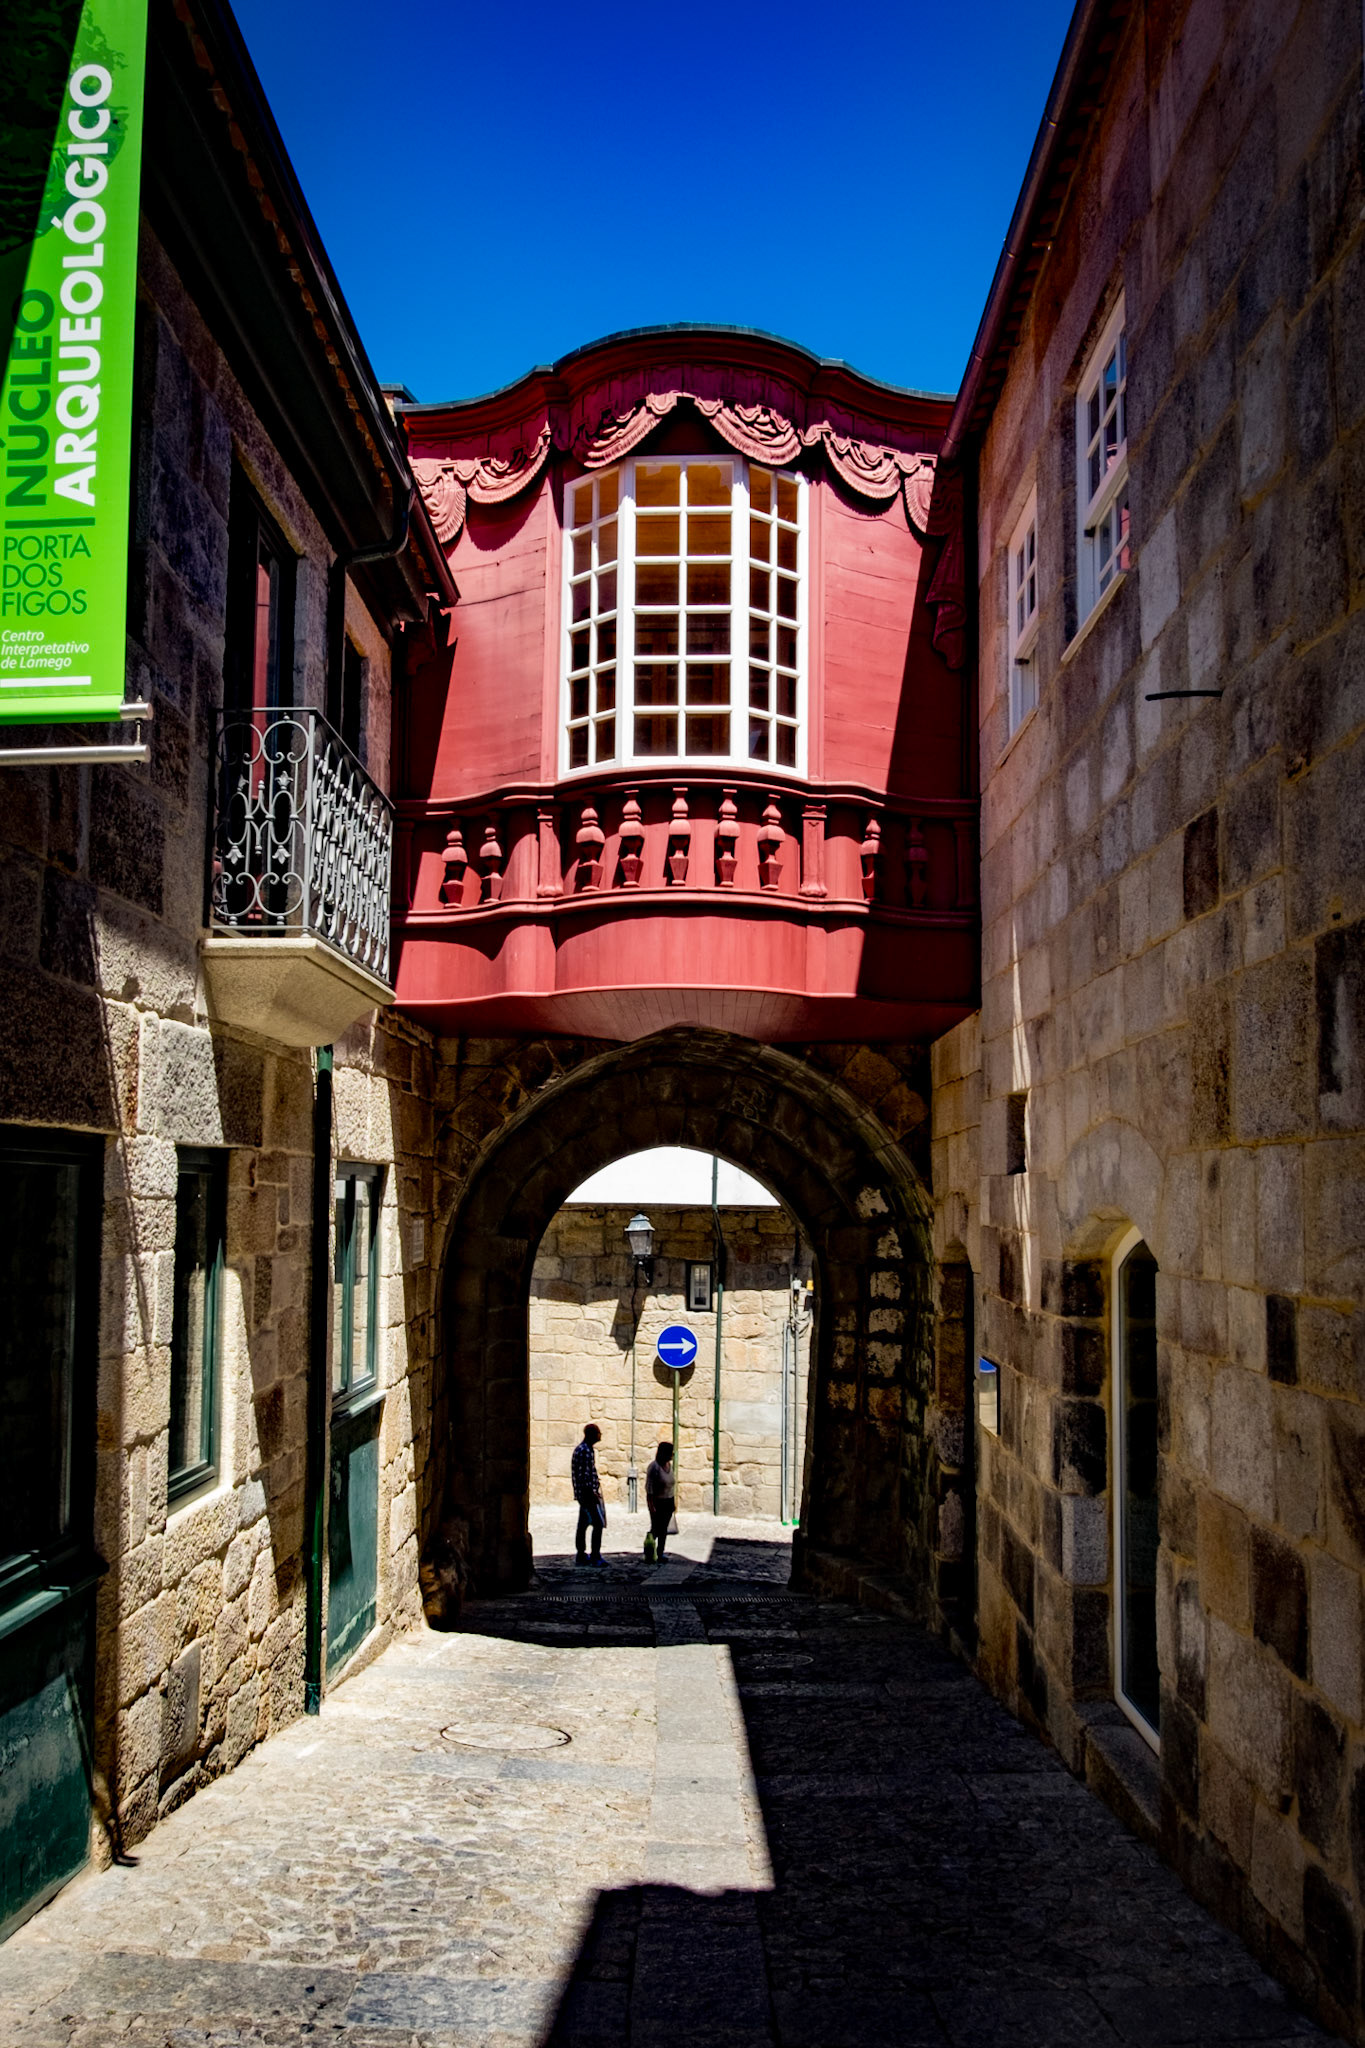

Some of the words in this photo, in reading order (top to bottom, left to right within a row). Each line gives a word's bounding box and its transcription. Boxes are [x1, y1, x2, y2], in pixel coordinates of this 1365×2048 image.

[51, 64, 112, 507] ARQUEOLÓGICO
[0, 289, 55, 507] NÚCLEO
[4, 533, 92, 561] PORTA
[2, 562, 63, 588] DOS
[1, 589, 88, 616] FIGOS
[1, 629, 45, 642] Centro
[1, 641, 90, 657] Interpretativo
[0, 656, 17, 670] de
[19, 656, 72, 671] Lamego
